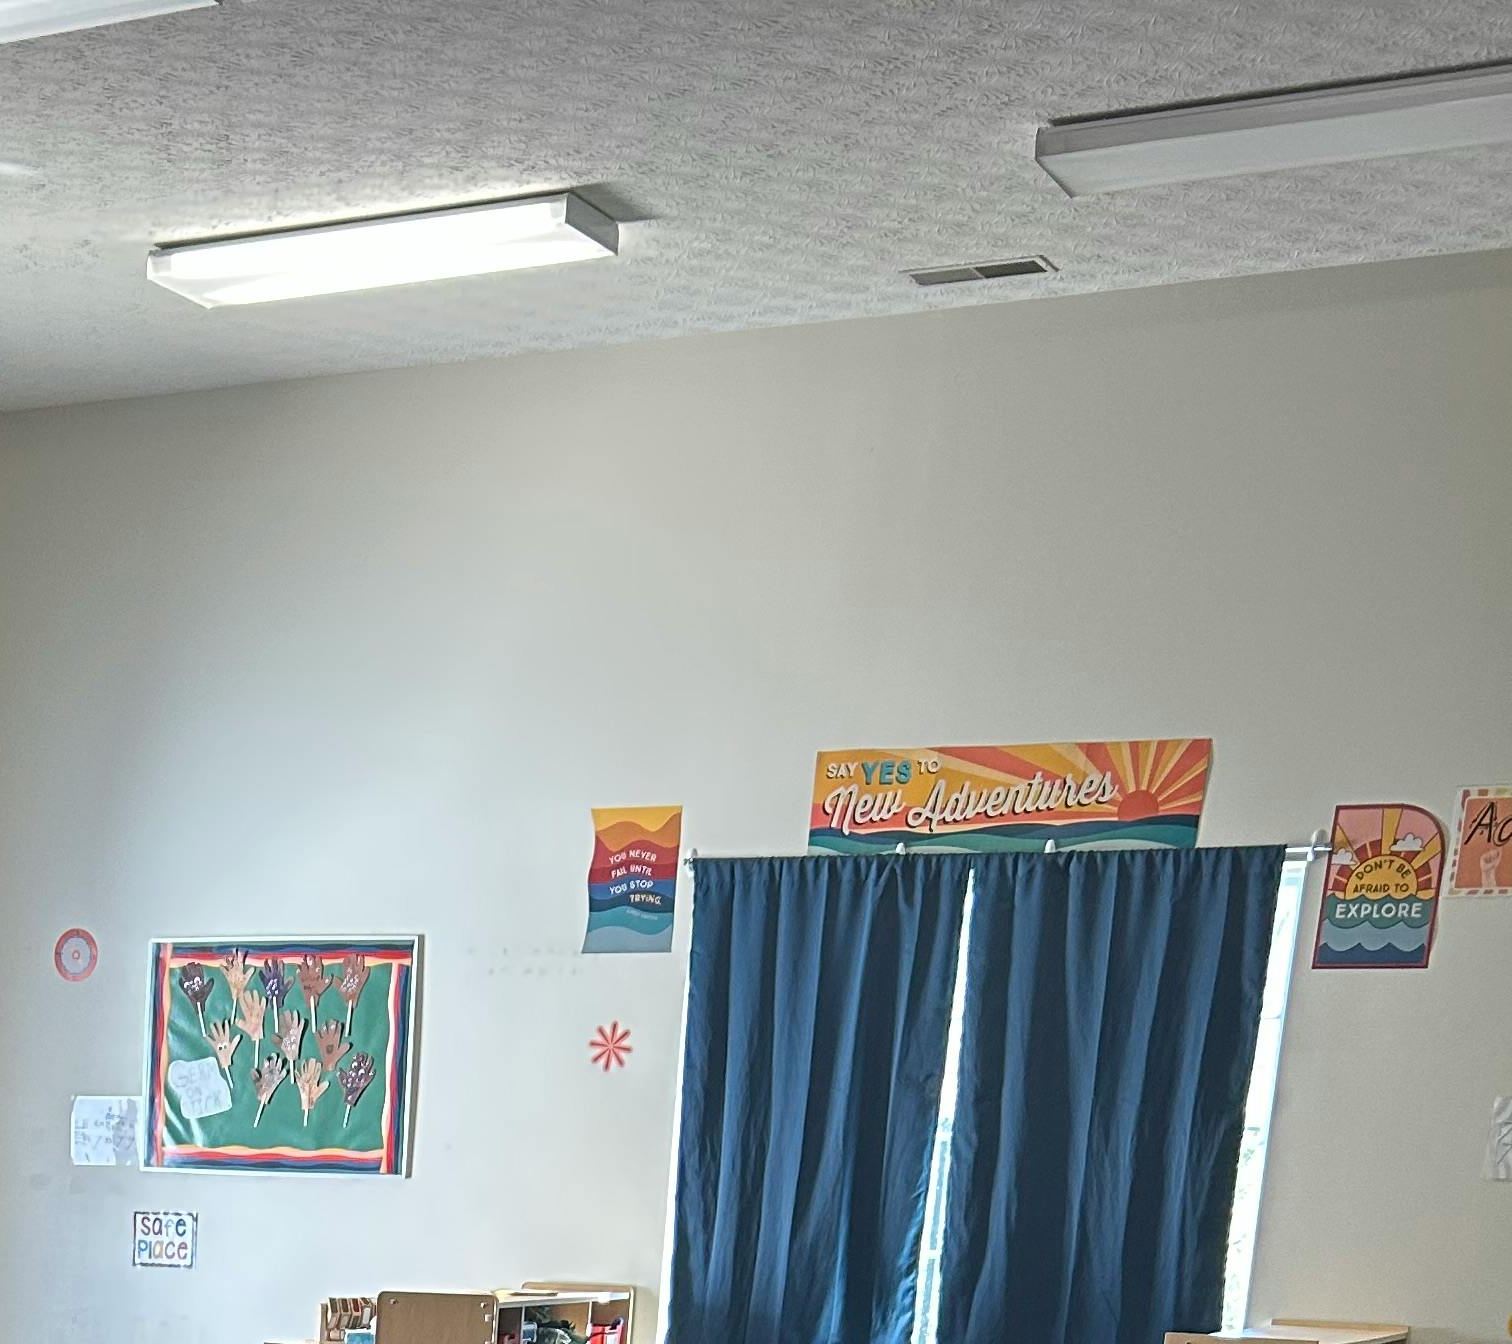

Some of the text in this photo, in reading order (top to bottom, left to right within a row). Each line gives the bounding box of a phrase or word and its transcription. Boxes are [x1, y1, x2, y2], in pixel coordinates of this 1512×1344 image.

[826, 759, 940, 785] SAY YES TO
[823, 770, 1120, 836] New Adventures
[608, 849, 657, 865] YOU NEVER
[610, 864, 653, 879] FAIL UNTIL
[1355, 859, 1412, 881] DON'T BE
[609, 880, 654, 895] YOU STOP
[1353, 883, 1410, 894] AFRAID TO
[1335, 902, 1423, 919] EXPLORE
